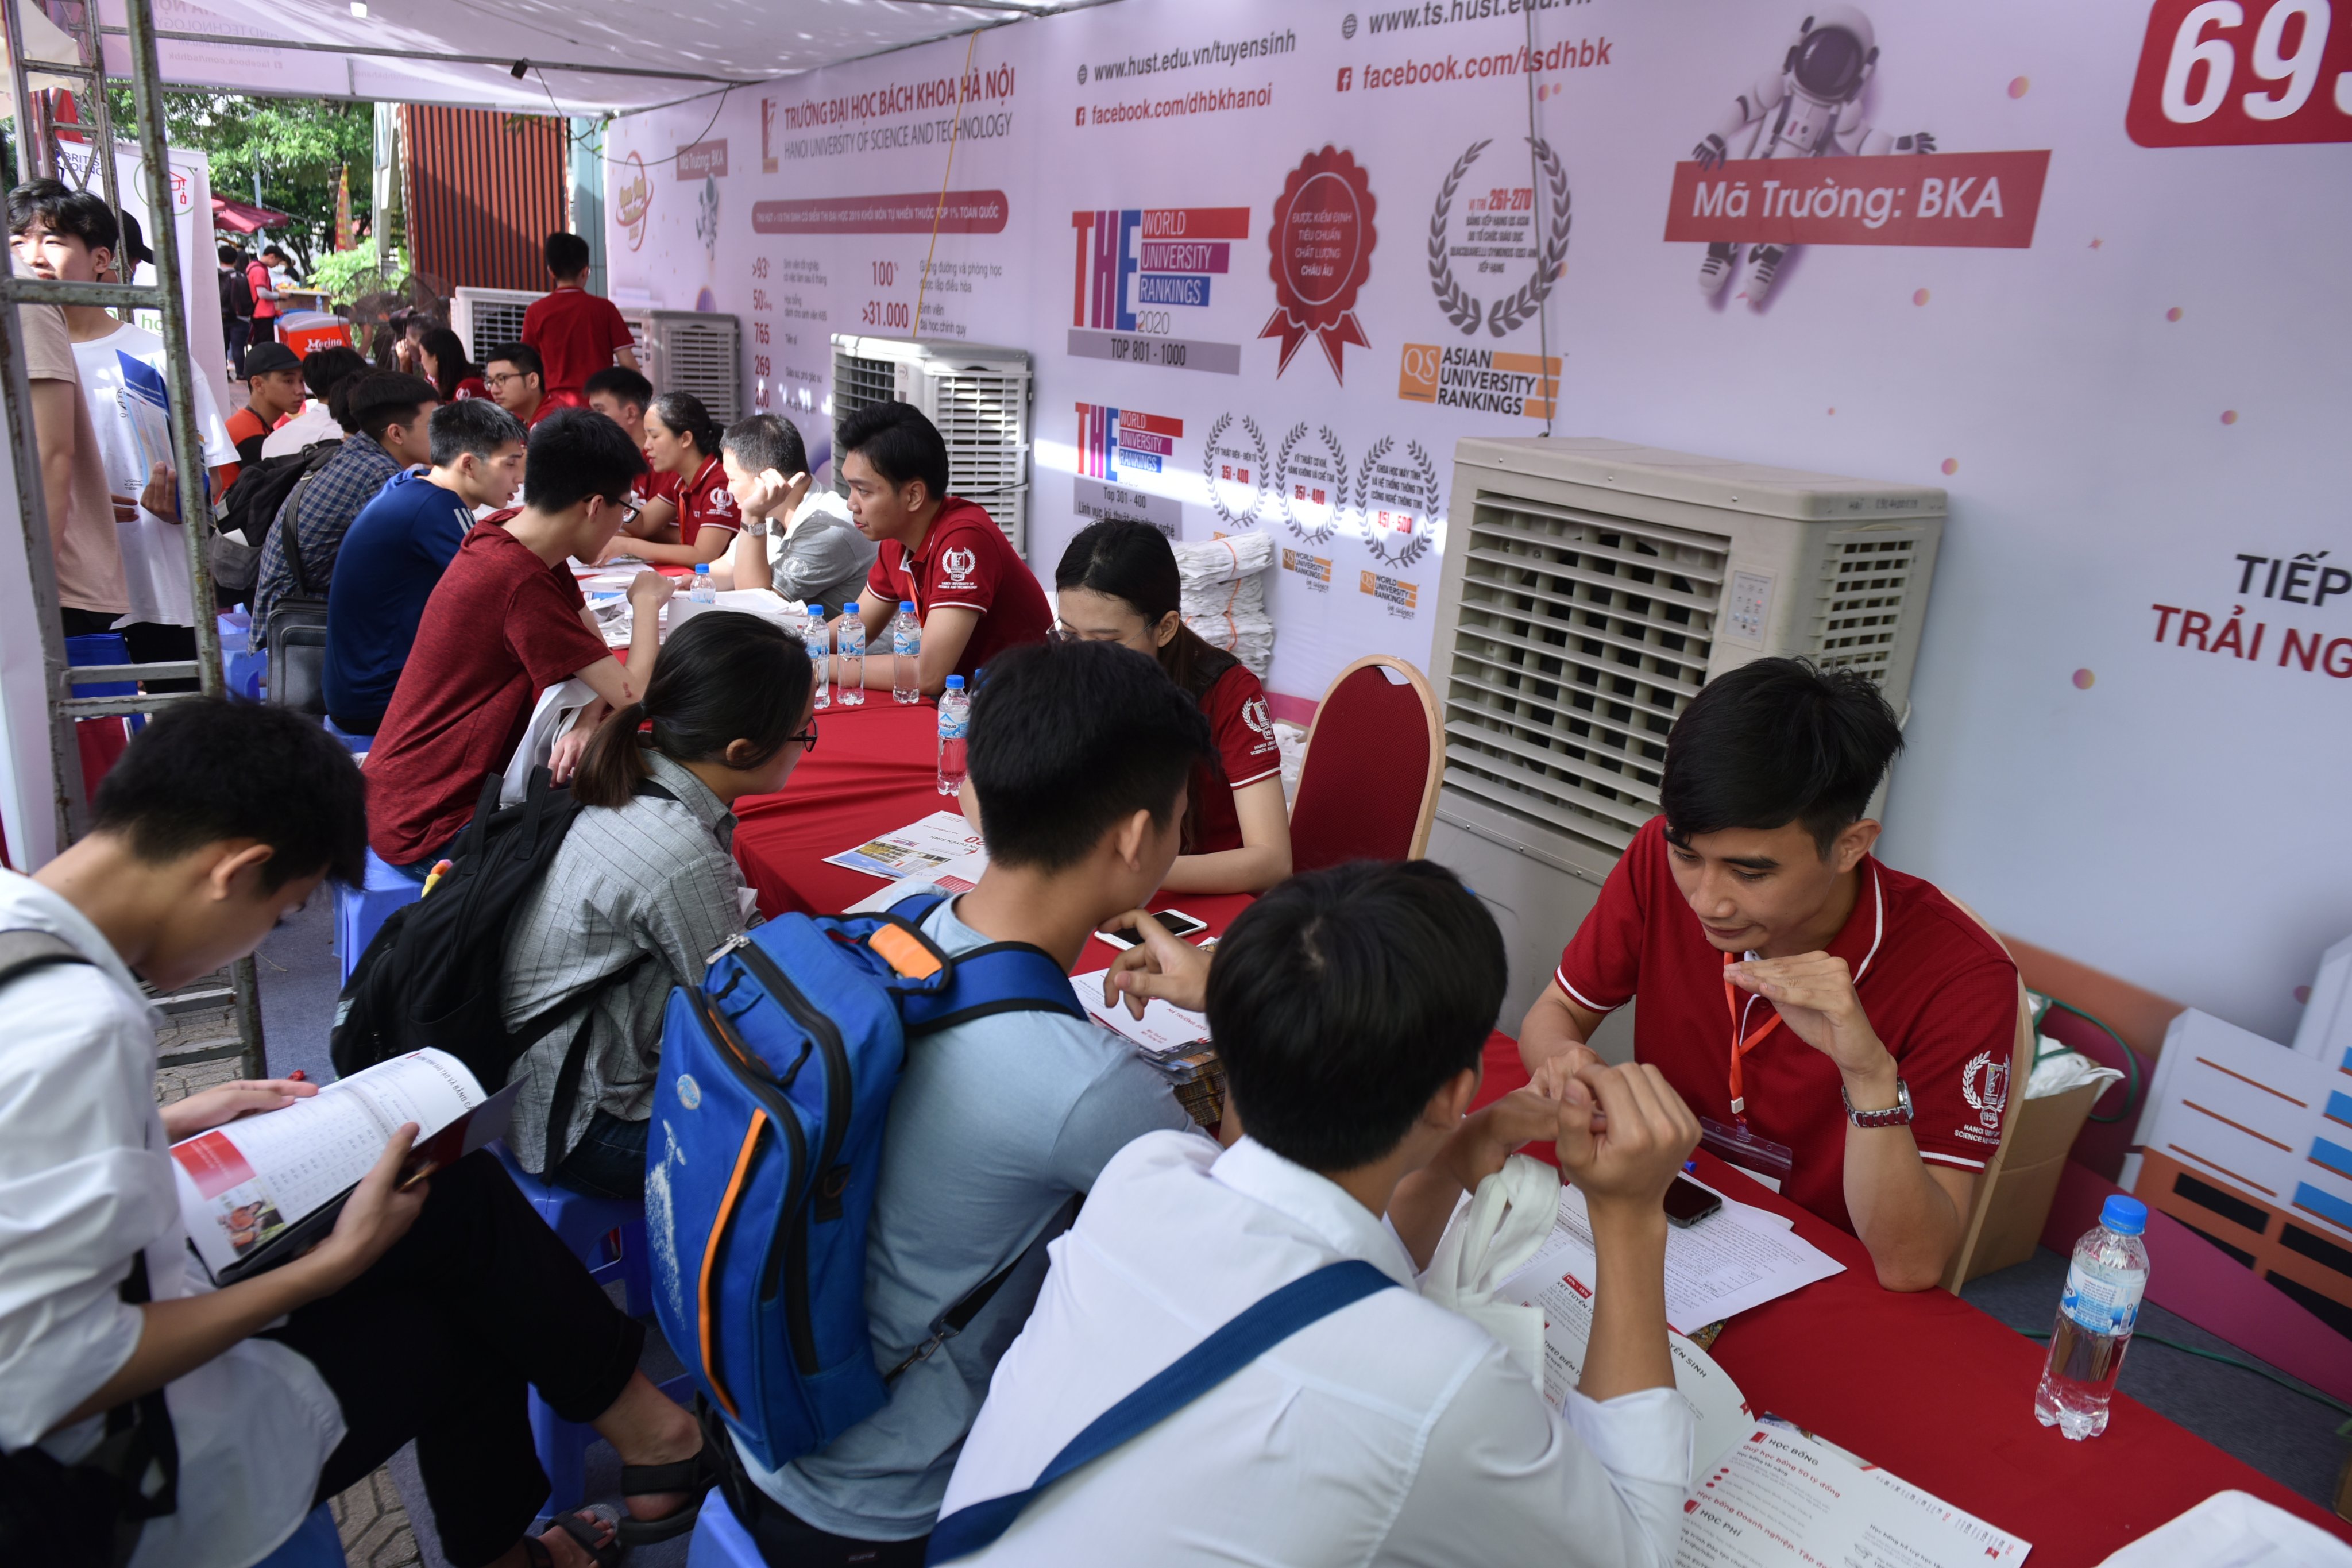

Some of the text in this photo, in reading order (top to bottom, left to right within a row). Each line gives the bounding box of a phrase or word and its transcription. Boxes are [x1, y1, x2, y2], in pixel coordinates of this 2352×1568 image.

[1095, 28, 1296, 81] www.hust.edu.vn/tuyensinh
[1364, 37, 1613, 90] facebook.com/tsdhbk
[2161, 0, 2352, 124] 69
[784, 62, 1015, 130] TRƯỜNG ĐẠI HỌC BÁCH KHOA HÀ NỘI
[1092, 82, 1273, 125] facebook.com/dhbkhanoi
[784, 112, 1013, 160] HANOI UNIVERSITY OF SCIENCE AND TECHNOLOGY
[1489, 188, 1534, 210] 261-270
[1693, 176, 2005, 230] Mã Trường: BKA
[1144, 211, 1186, 236] WORLD
[1141, 245, 1212, 270] UNIVERSITY
[1072, 210, 1141, 331] THE
[1140, 277, 1202, 304] RANKINGS
[862, 300, 909, 329] >31.000
[1138, 311, 1169, 334] 2020
[304, 337, 342, 352] Merino
[754, 322, 770, 345] 765
[1111, 338, 1186, 366] TOP 801 1000
[1442, 347, 1492, 369] ASIAN
[755, 355, 770, 377] 269
[1404, 348, 1437, 385] QS
[1440, 368, 1536, 395] UNIVERSITY
[1438, 387, 1523, 416] RANKINGS
[1120, 411, 1146, 429] WORLD
[1075, 402, 1119, 482] THE
[1120, 431, 1163, 452] UNIVERSITY
[1119, 450, 1157, 472] RANKINGS
[1222, 465, 1249, 484] 351 400
[1104, 486, 1146, 509] Top 301 400
[1295, 484, 1326, 505] 351 400
[1078, 501, 1090, 515] Lĩnh
[1397, 515, 1412, 534] 500
[1295, 551, 1314, 562] WORLD
[1295, 559, 1324, 573] UNIVERSITY
[1295, 566, 1321, 580] RANKINGS
[1361, 572, 1374, 588] QS
[1376, 574, 1397, 586] WORLD
[2235, 551, 2352, 607] TIẾP
[1374, 590, 1405, 605] RANKINGS
[1375, 582, 1409, 598] UNIVERSITY
[2152, 604, 2266, 661] TRẢI
[1954, 1130, 1982, 1142] SCIENCE
[1964, 1124, 1984, 1134] HANOI
[1545, 1340, 1559, 1355] THEO
[1686, 1358, 1706, 1378] SINH
[1768, 1438, 1819, 1466] HỌC BỔNG
[1743, 1445, 1759, 1454] Quỹ
[1760, 1450, 1774, 1461] học
[1776, 1457, 1797, 1472] bổng
[1798, 1469, 1809, 1478] 50
[1820, 1481, 1841, 1498] đồng
[1696, 1490, 1713, 1501] Học
[1713, 1497, 1735, 1513] bổng
[1736, 1510, 1763, 1531] Doanh
[1798, 1549, 1814, 1563] Tập
[1700, 1509, 1744, 1538] HỌC PHÍ
